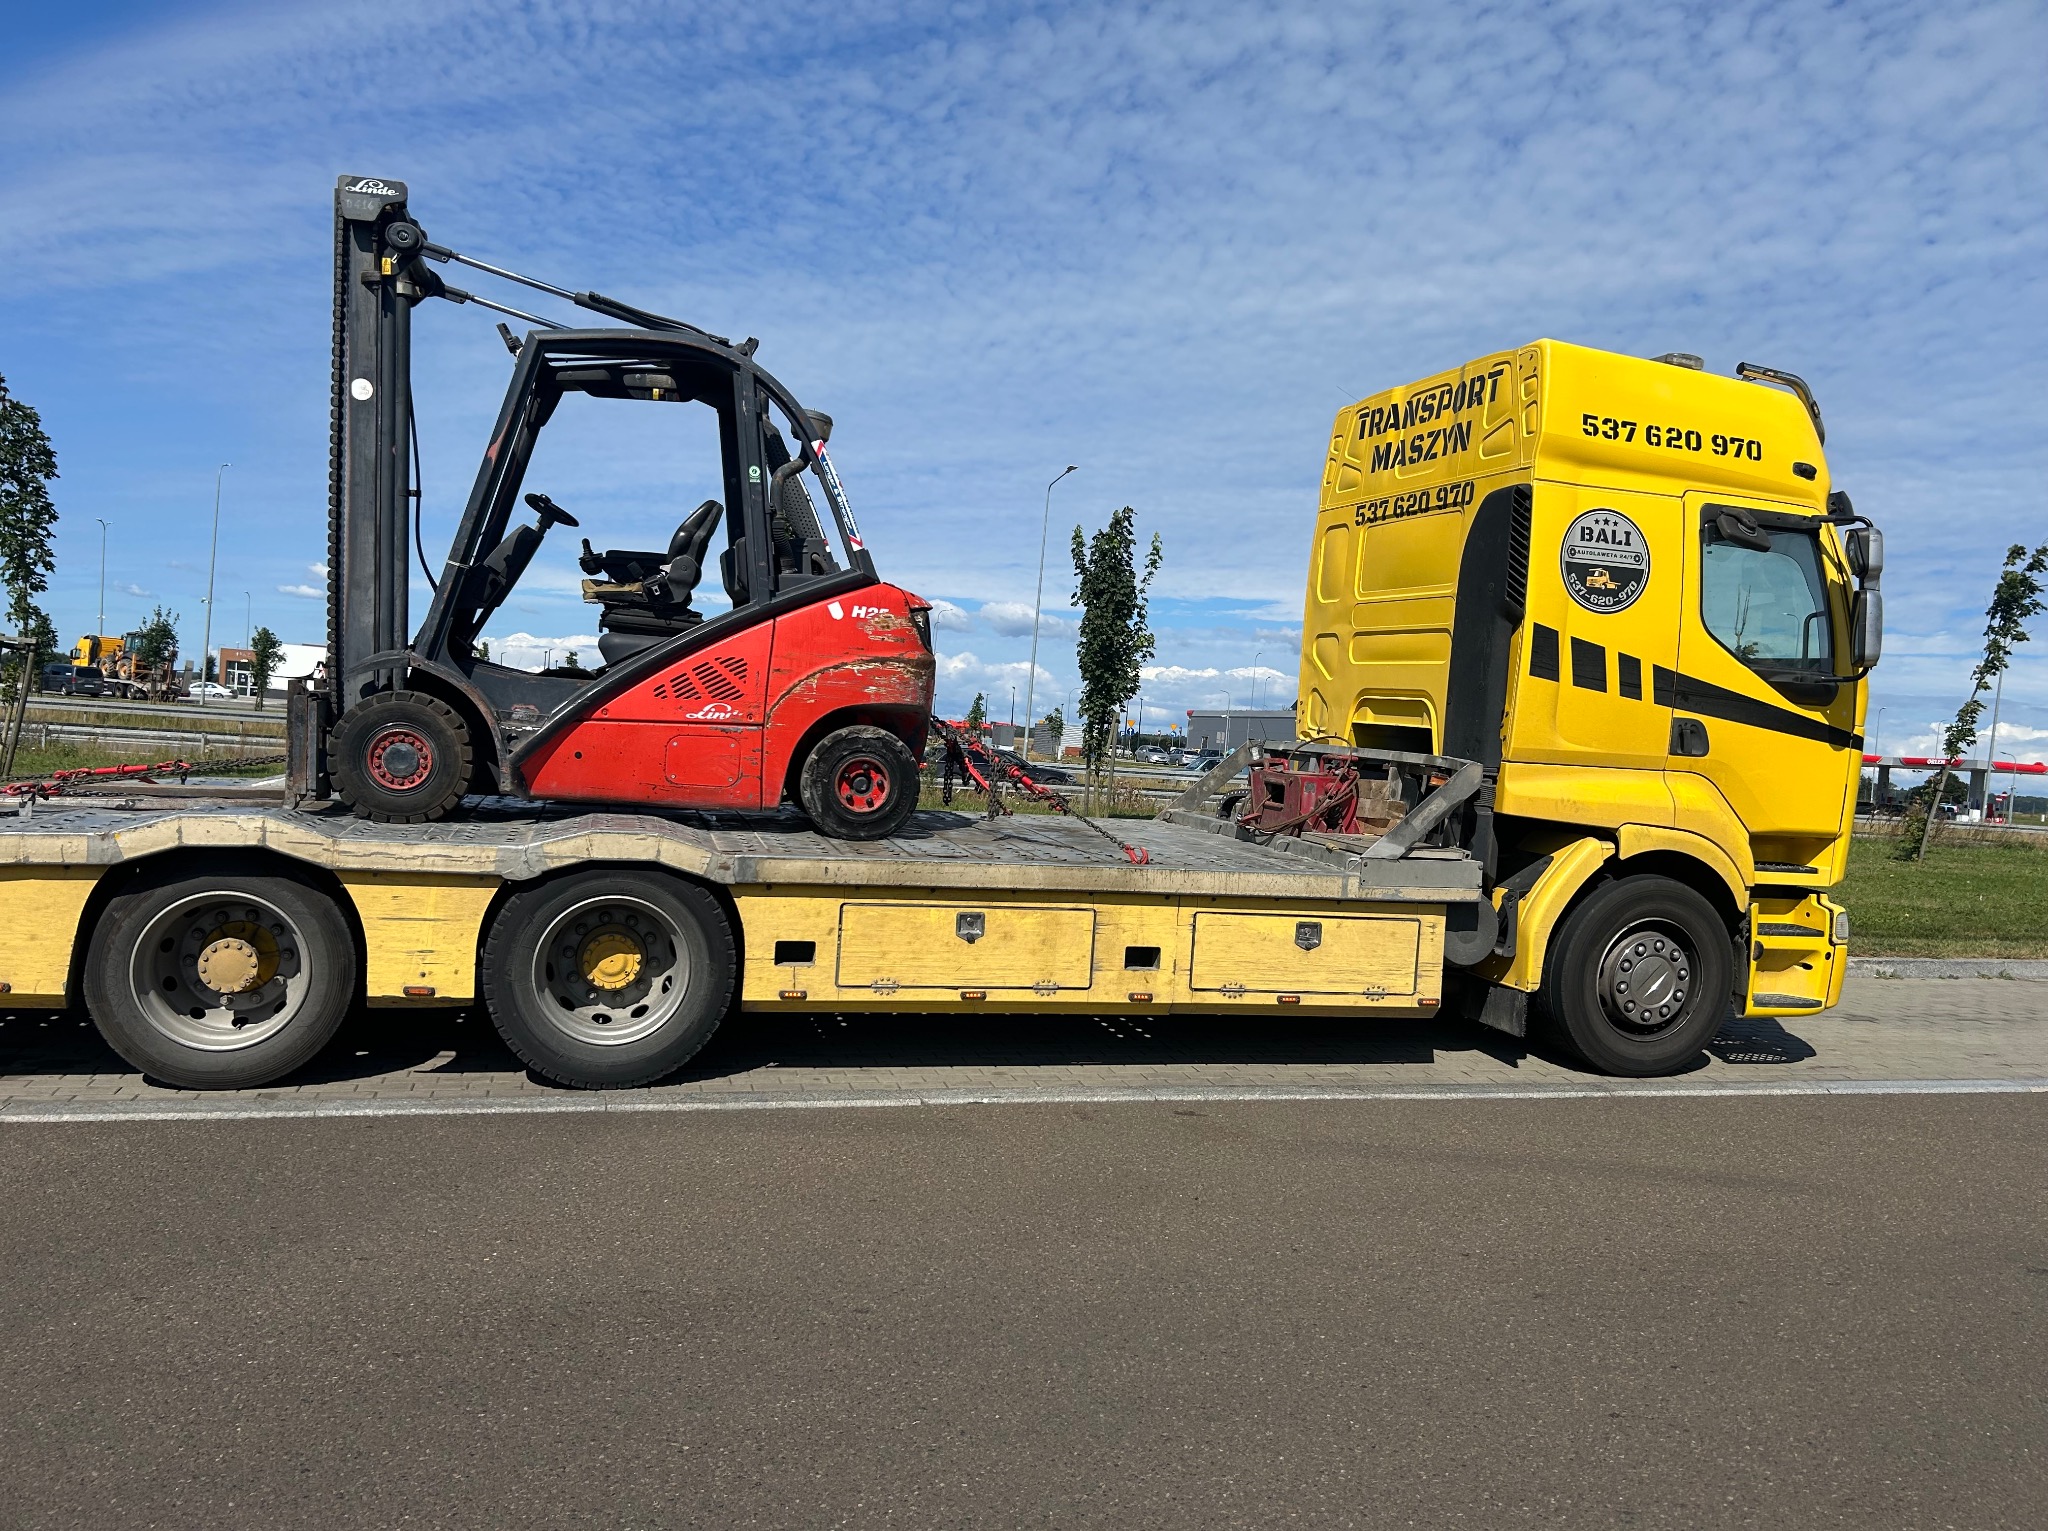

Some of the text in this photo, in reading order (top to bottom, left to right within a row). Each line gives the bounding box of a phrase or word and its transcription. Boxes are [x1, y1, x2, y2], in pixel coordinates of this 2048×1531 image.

[345, 179, 399, 196] Linde
[1358, 368, 1504, 440] TRANSPORT
[1370, 420, 1472, 473] MASZYN
[1582, 413, 1762, 461] 537 620 970
[1354, 481, 1475, 526] 537 620 970
[1580, 525, 1632, 547] BALI
[1576, 549, 1618, 559] AUTOLAWETA
[1568, 572, 1638, 606] 537-620-970
[685, 702, 744, 720] Lin
